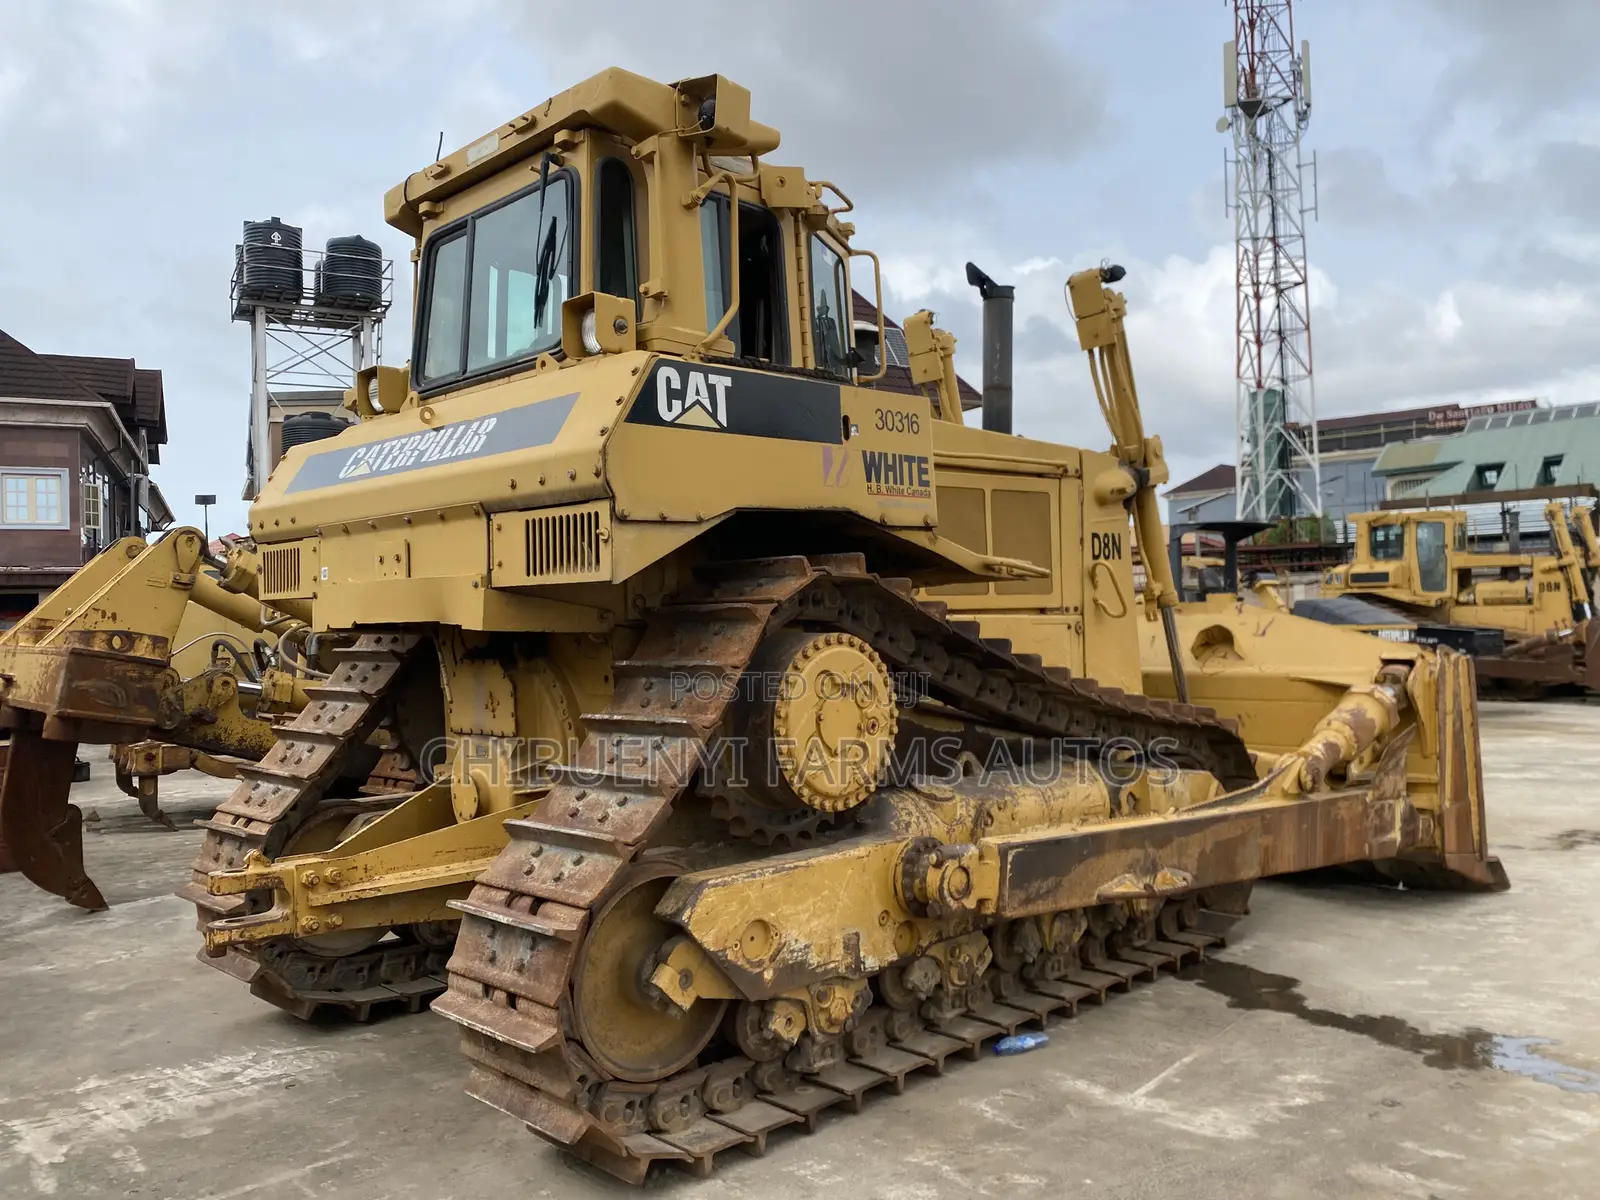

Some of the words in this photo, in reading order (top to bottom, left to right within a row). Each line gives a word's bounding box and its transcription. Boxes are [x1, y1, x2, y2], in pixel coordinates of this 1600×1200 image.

[656, 366, 732, 427] CAT
[874, 408, 920, 434] 30316
[339, 417, 498, 479] CATERPILLAR
[862, 450, 930, 487] WHITE
[885, 486, 905, 495] White
[906, 487, 931, 497] Canada
[1091, 532, 1122, 561] D8N
